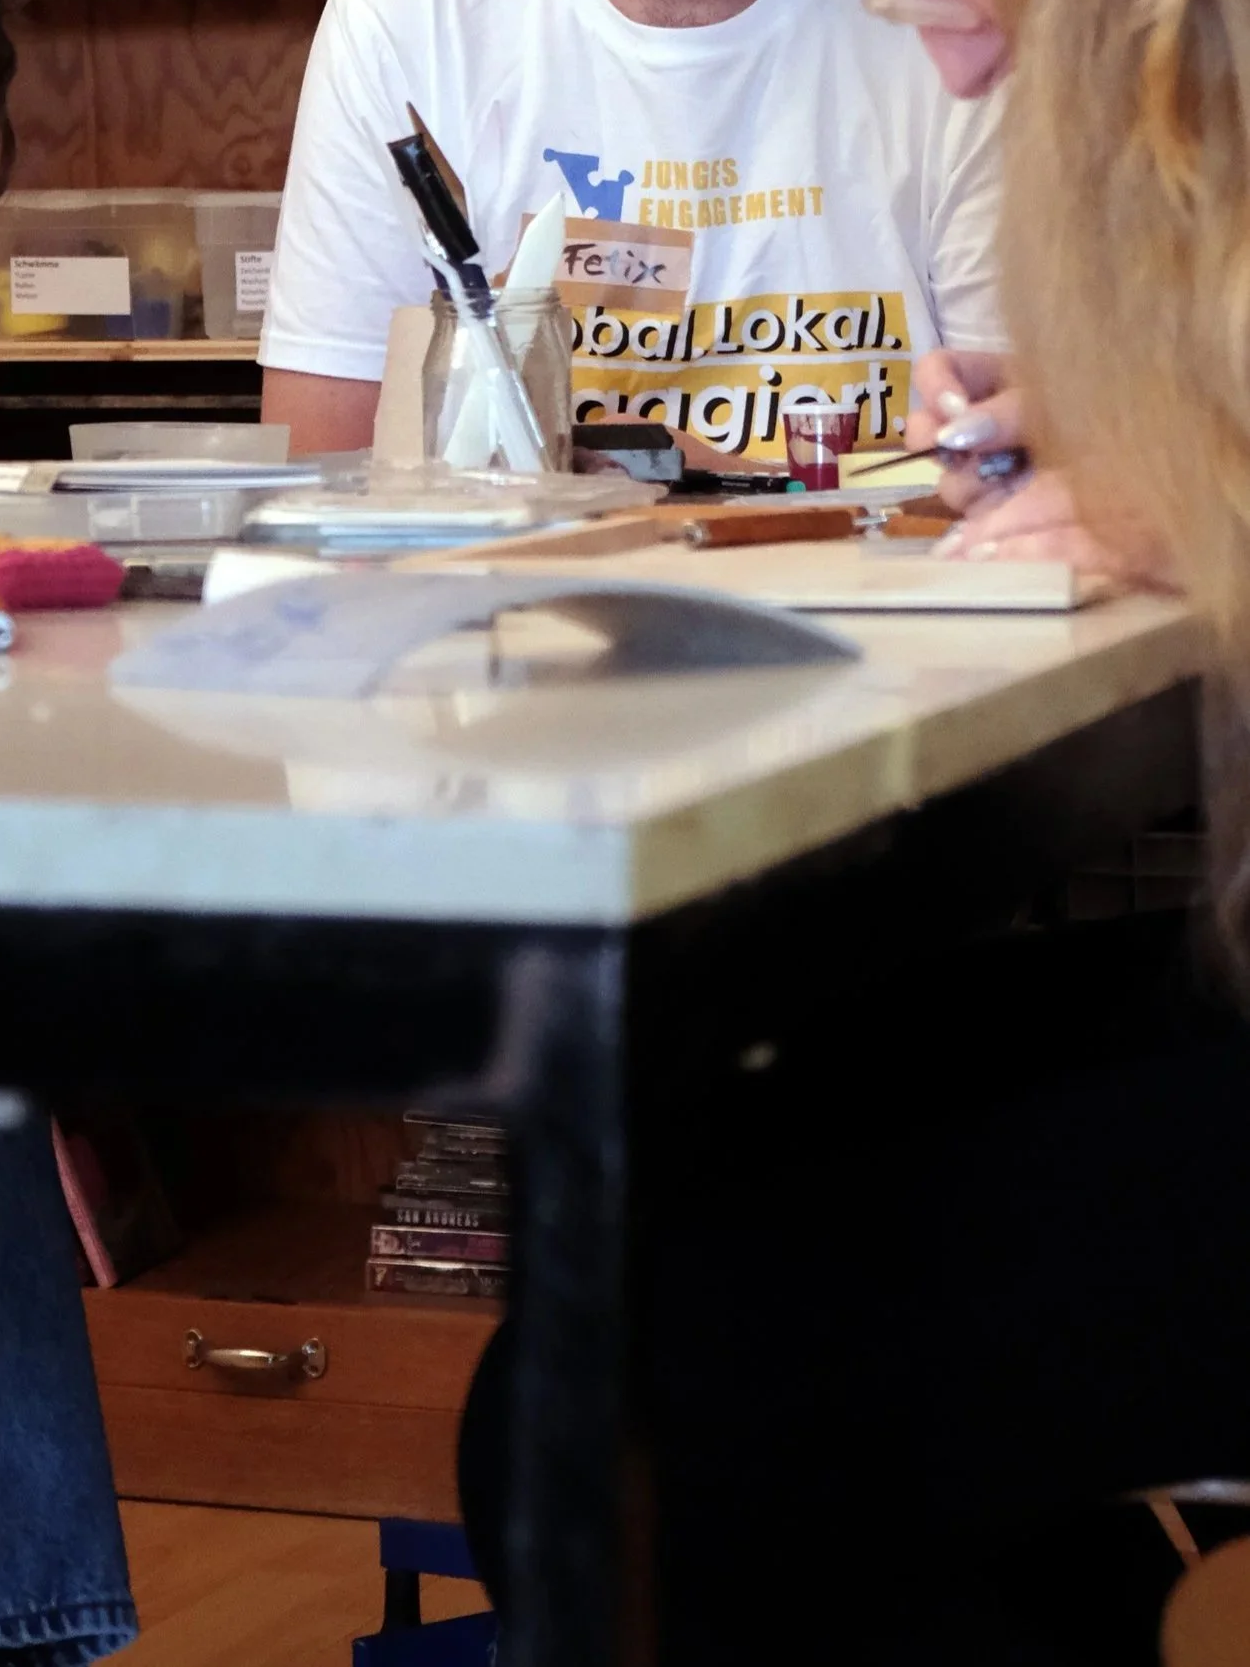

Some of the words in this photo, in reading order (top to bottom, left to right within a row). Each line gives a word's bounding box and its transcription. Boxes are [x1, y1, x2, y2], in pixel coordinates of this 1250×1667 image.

[641, 158, 739, 191] JUNGES
[638, 186, 825, 229] ENGAGEMENT
[563, 243, 667, 284] Felix
[572, 305, 709, 361] bal.
